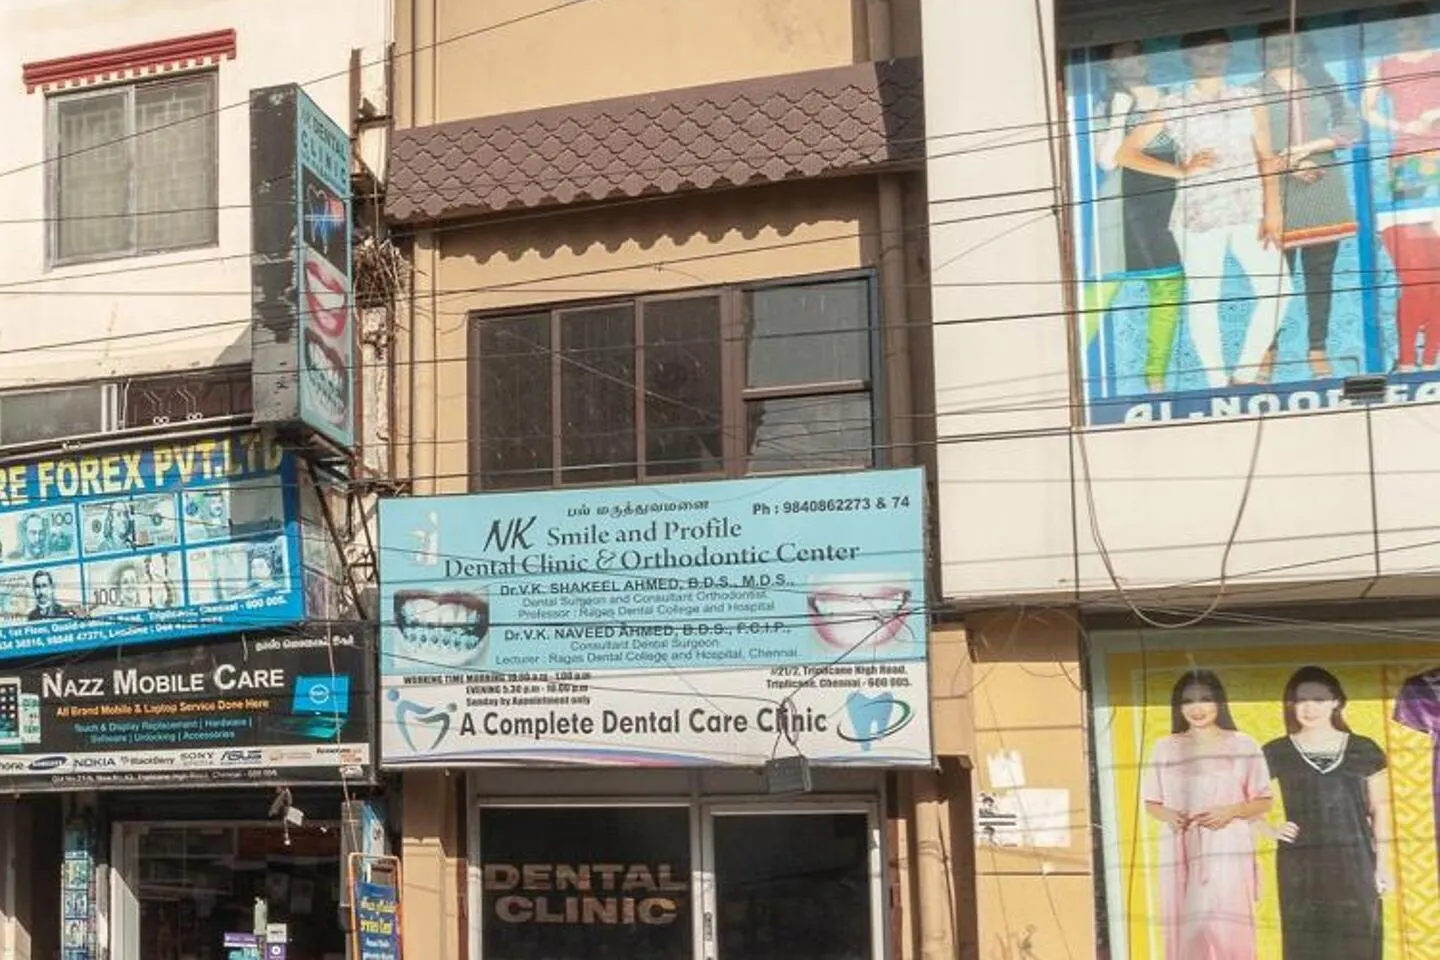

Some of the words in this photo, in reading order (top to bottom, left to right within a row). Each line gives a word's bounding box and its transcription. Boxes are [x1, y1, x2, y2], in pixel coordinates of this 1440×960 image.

[38, 450, 146, 502] FOREX
[893, 496, 910, 508] 74
[482, 515, 538, 553] NK
[547, 523, 610, 547] Smile
[615, 521, 657, 543] and
[664, 516, 742, 540] Profile
[444, 554, 515, 578] Dental
[522, 553, 590, 573] Clinic
[596, 548, 617, 570] &
[620, 545, 770, 571] Orthodontic
[776, 541, 860, 562] Center
[550, 581, 620, 594] SHAKEEL
[554, 626, 616, 639] NAVEED
[101, 703, 134, 716] Mobile
[180, 700, 217, 712] Service
[218, 698, 244, 711] Done
[459, 712, 476, 736] A
[484, 710, 594, 740] Complete
[602, 708, 680, 734] Dental
[688, 707, 748, 733] Care
[757, 706, 827, 733] Clinic
[73, 757, 116, 768] NOKIA
[483, 863, 688, 891] DENTAL
[495, 896, 678, 925] CLINIC
